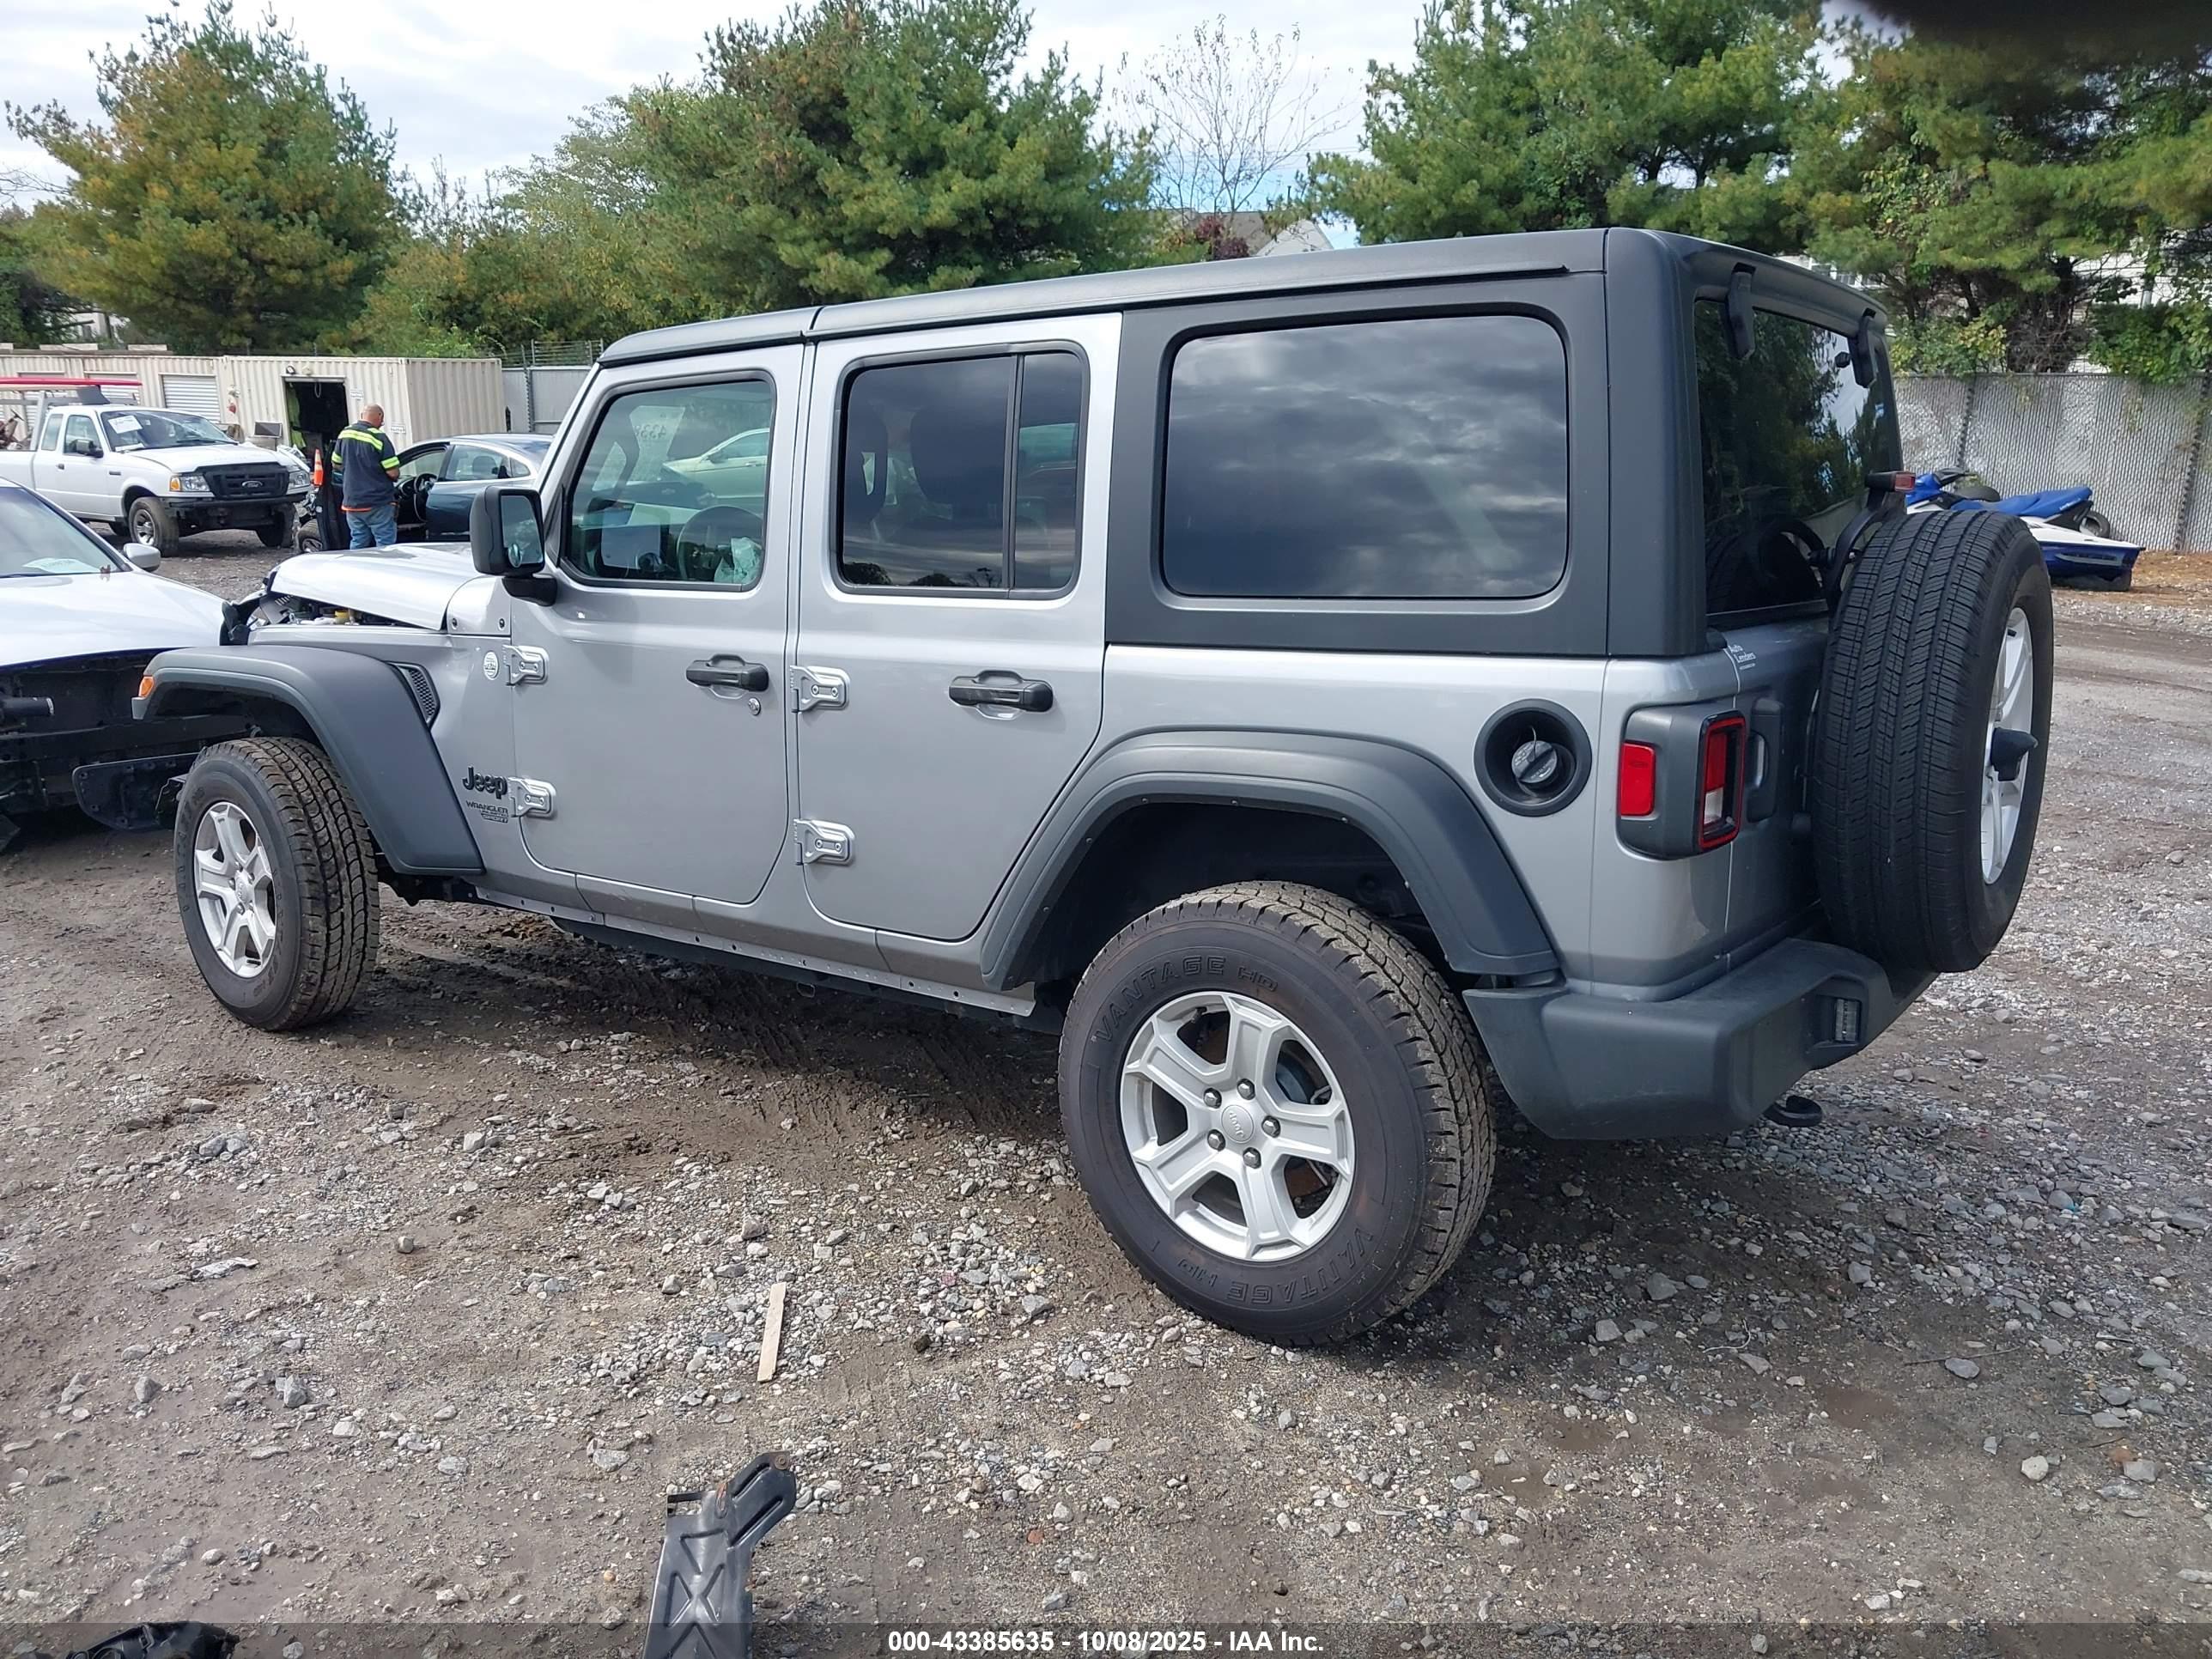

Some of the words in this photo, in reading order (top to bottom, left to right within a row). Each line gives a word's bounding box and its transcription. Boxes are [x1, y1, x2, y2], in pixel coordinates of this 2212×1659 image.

[462, 765, 507, 800] Jeep
[465, 800, 508, 815] WRANGLER
[1095, 954, 1227, 1043] VANTAGE
[1237, 965, 1279, 992] HD
[1226, 1227, 1376, 1305] VANTAGE
